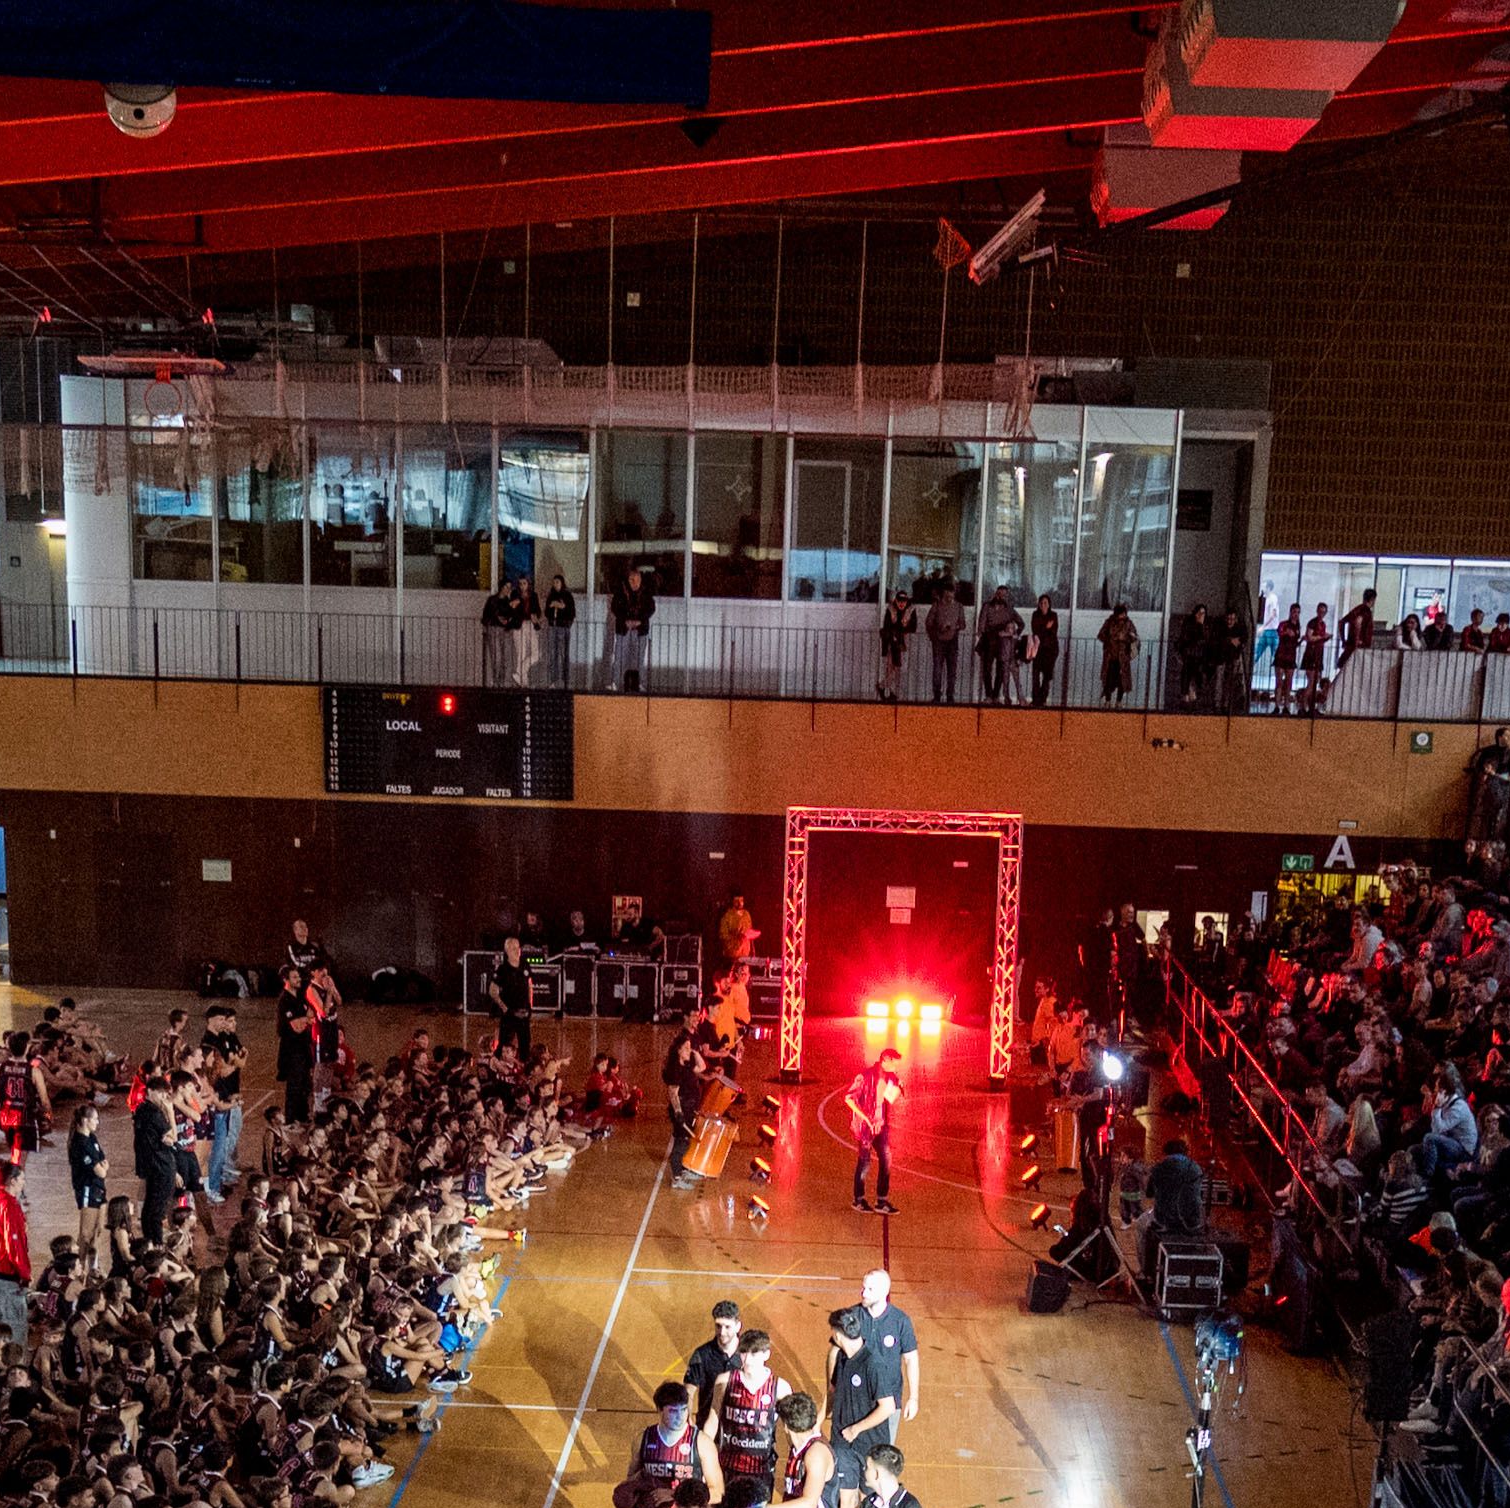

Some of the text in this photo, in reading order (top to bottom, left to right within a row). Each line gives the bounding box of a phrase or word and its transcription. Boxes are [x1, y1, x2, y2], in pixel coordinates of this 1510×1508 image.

[385, 720, 422, 732] LOCAL
[477, 723, 509, 734] VISITANT
[435, 748, 461, 759] PERIODE
[385, 784, 412, 794] FALTES
[431, 786, 464, 796] JUGADOR
[485, 787, 512, 798] FALTES
[1324, 835, 1355, 869] A
[732, 1435, 770, 1449] Occident
